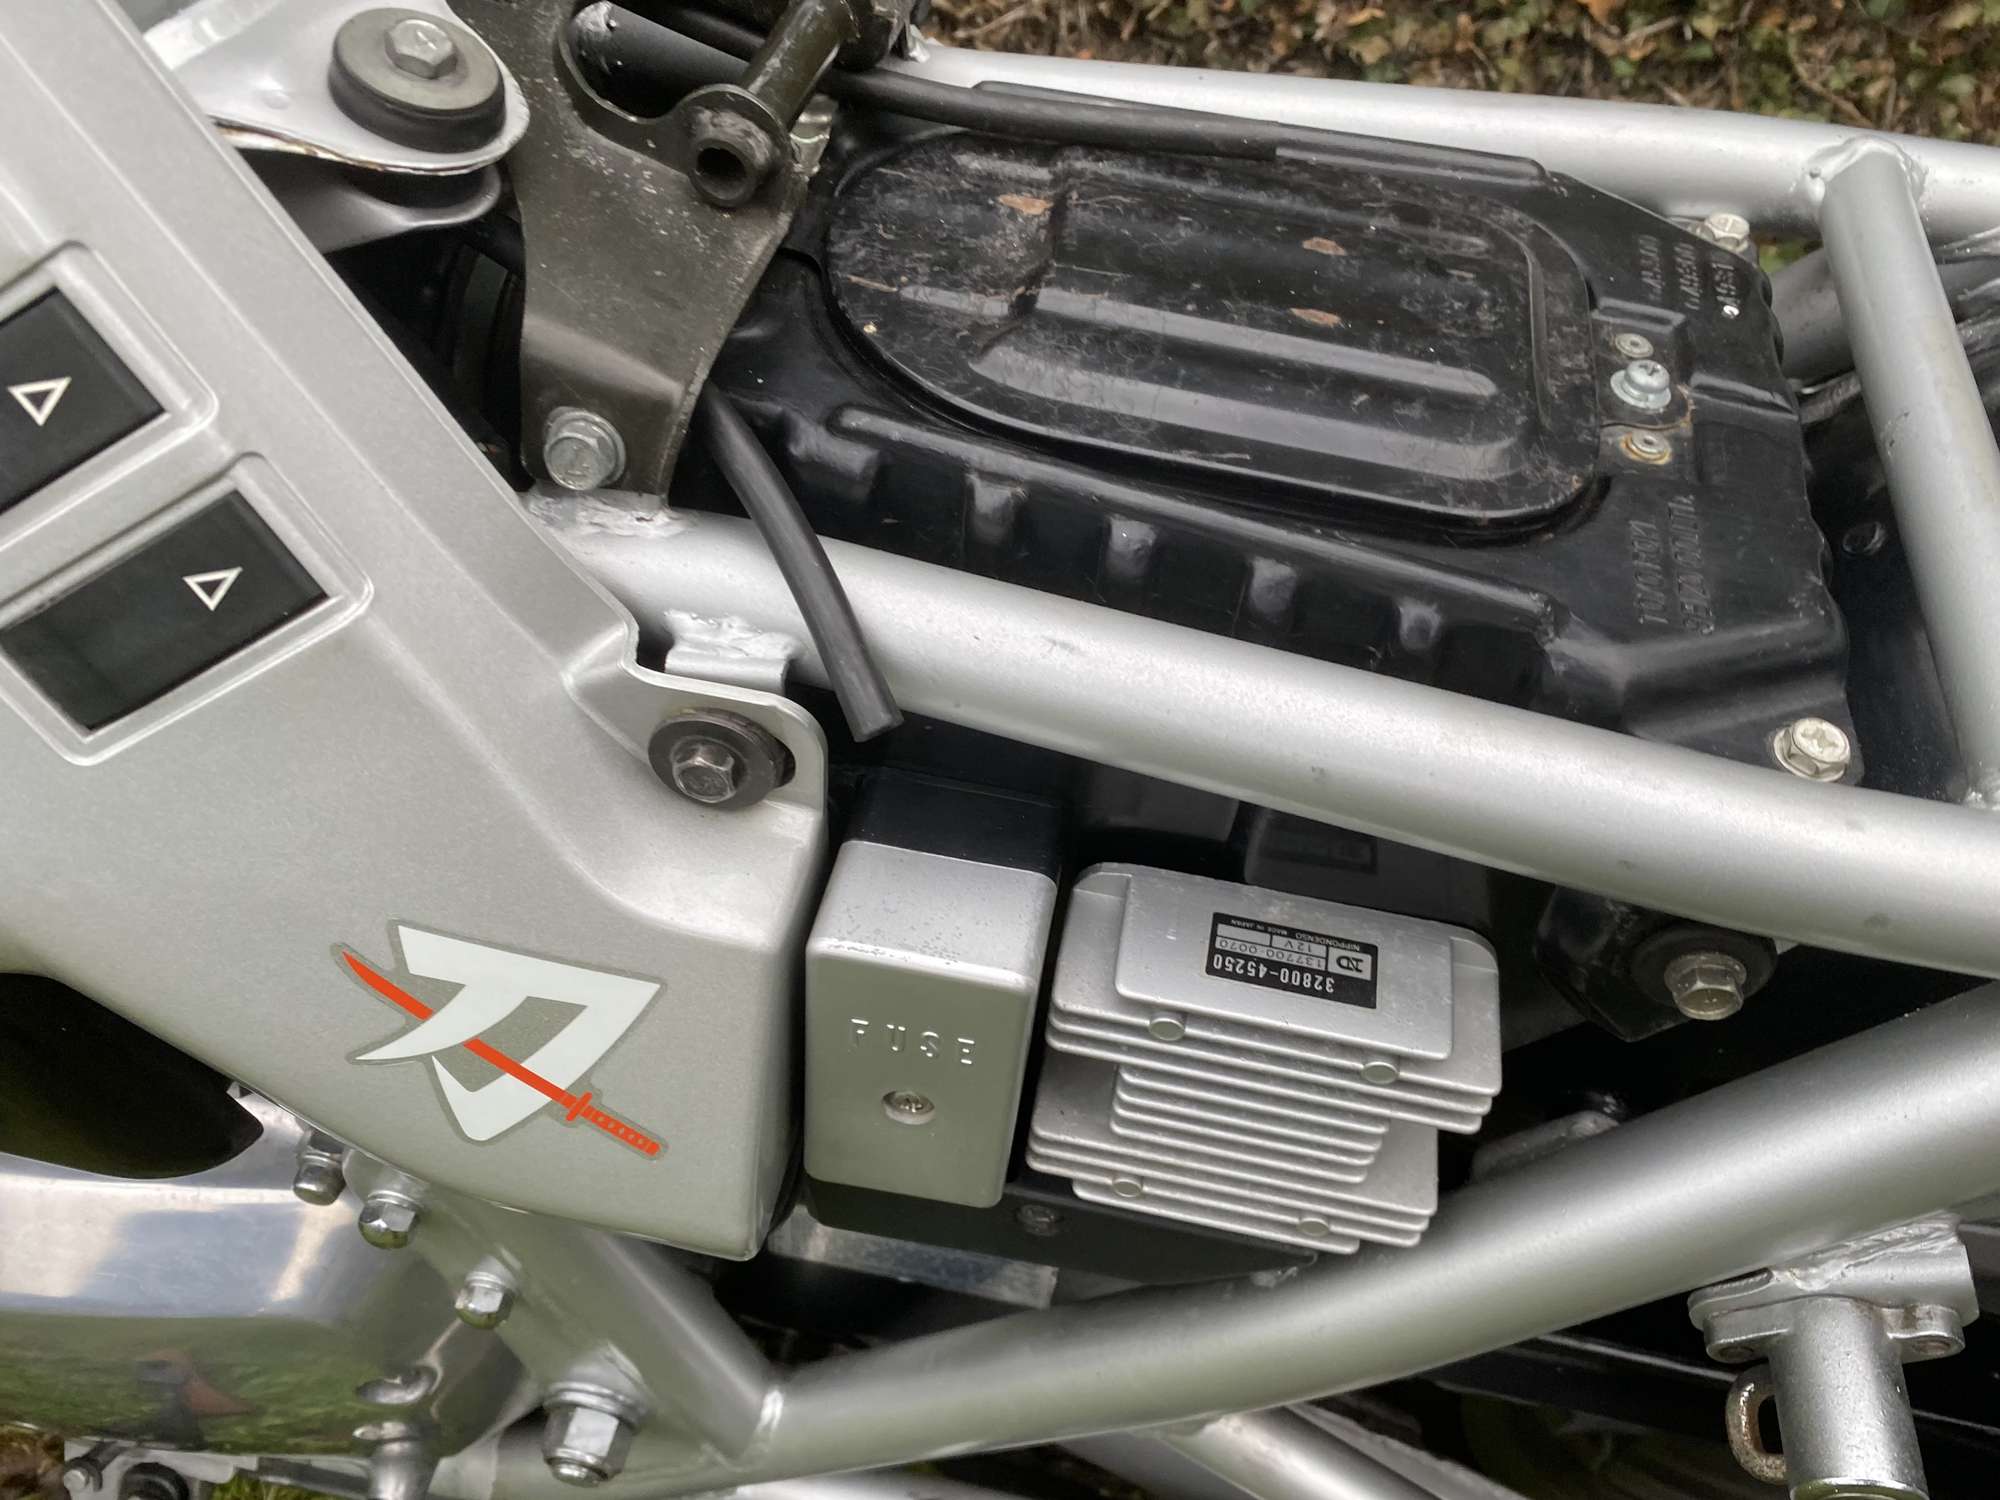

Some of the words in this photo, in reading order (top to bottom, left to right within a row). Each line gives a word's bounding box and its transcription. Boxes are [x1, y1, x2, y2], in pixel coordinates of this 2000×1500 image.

[1230, 918, 1256, 929] JAPAN
[1267, 926, 1288, 936] MADE
[1295, 931, 1361, 952] NIPPONDENSO
[1212, 953, 1336, 994] 32800-45250
[849, 1017, 976, 1066] FUSE
